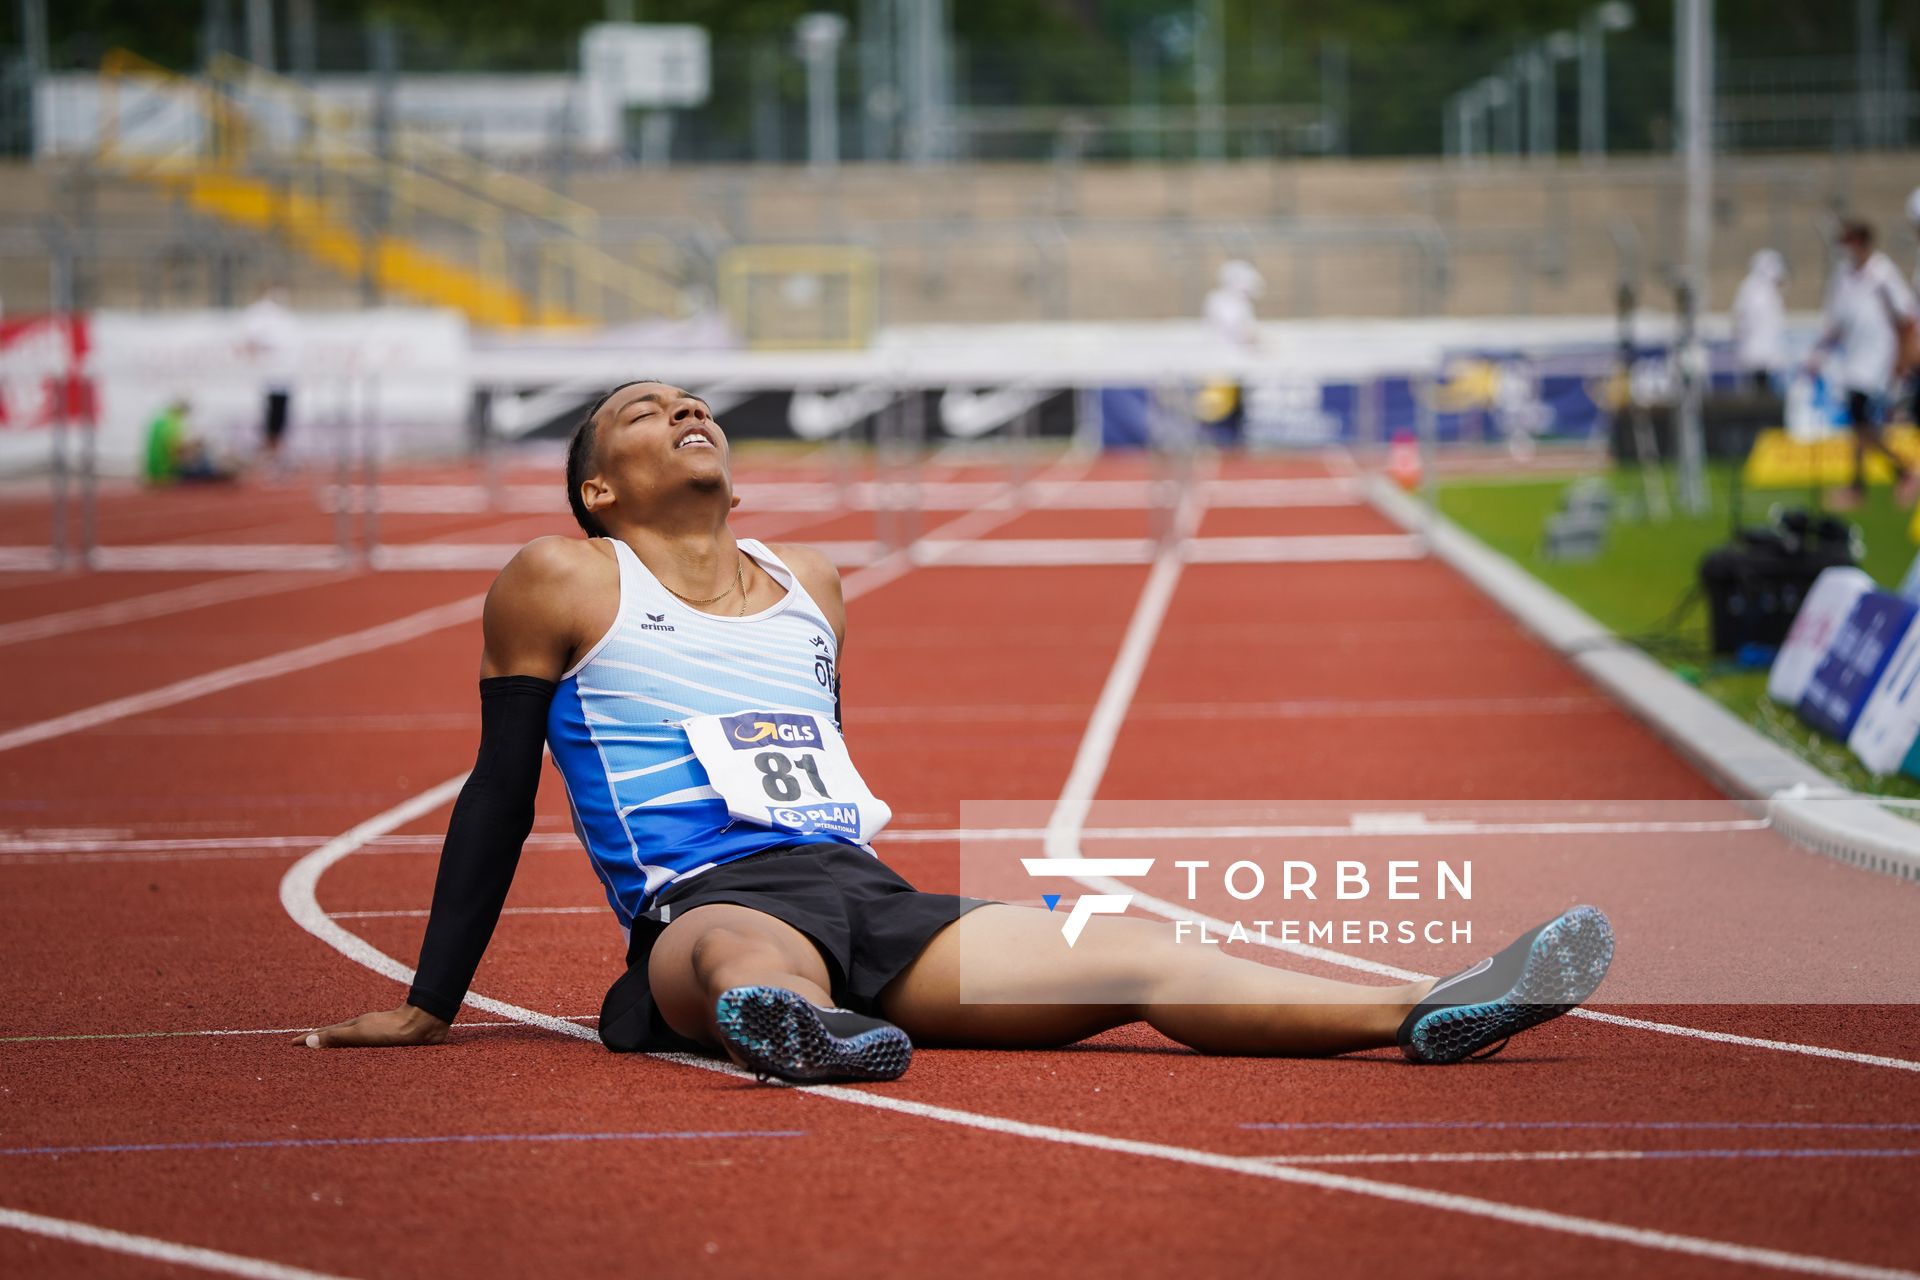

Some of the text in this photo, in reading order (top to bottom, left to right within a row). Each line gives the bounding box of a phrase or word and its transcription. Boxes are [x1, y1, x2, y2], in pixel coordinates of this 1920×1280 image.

[641, 623, 675, 632] erima
[778, 723, 815, 742] GLS
[754, 752, 832, 802] 81
[806, 807, 857, 825] PLAN
[814, 822, 856, 834] INTERNATIONAL
